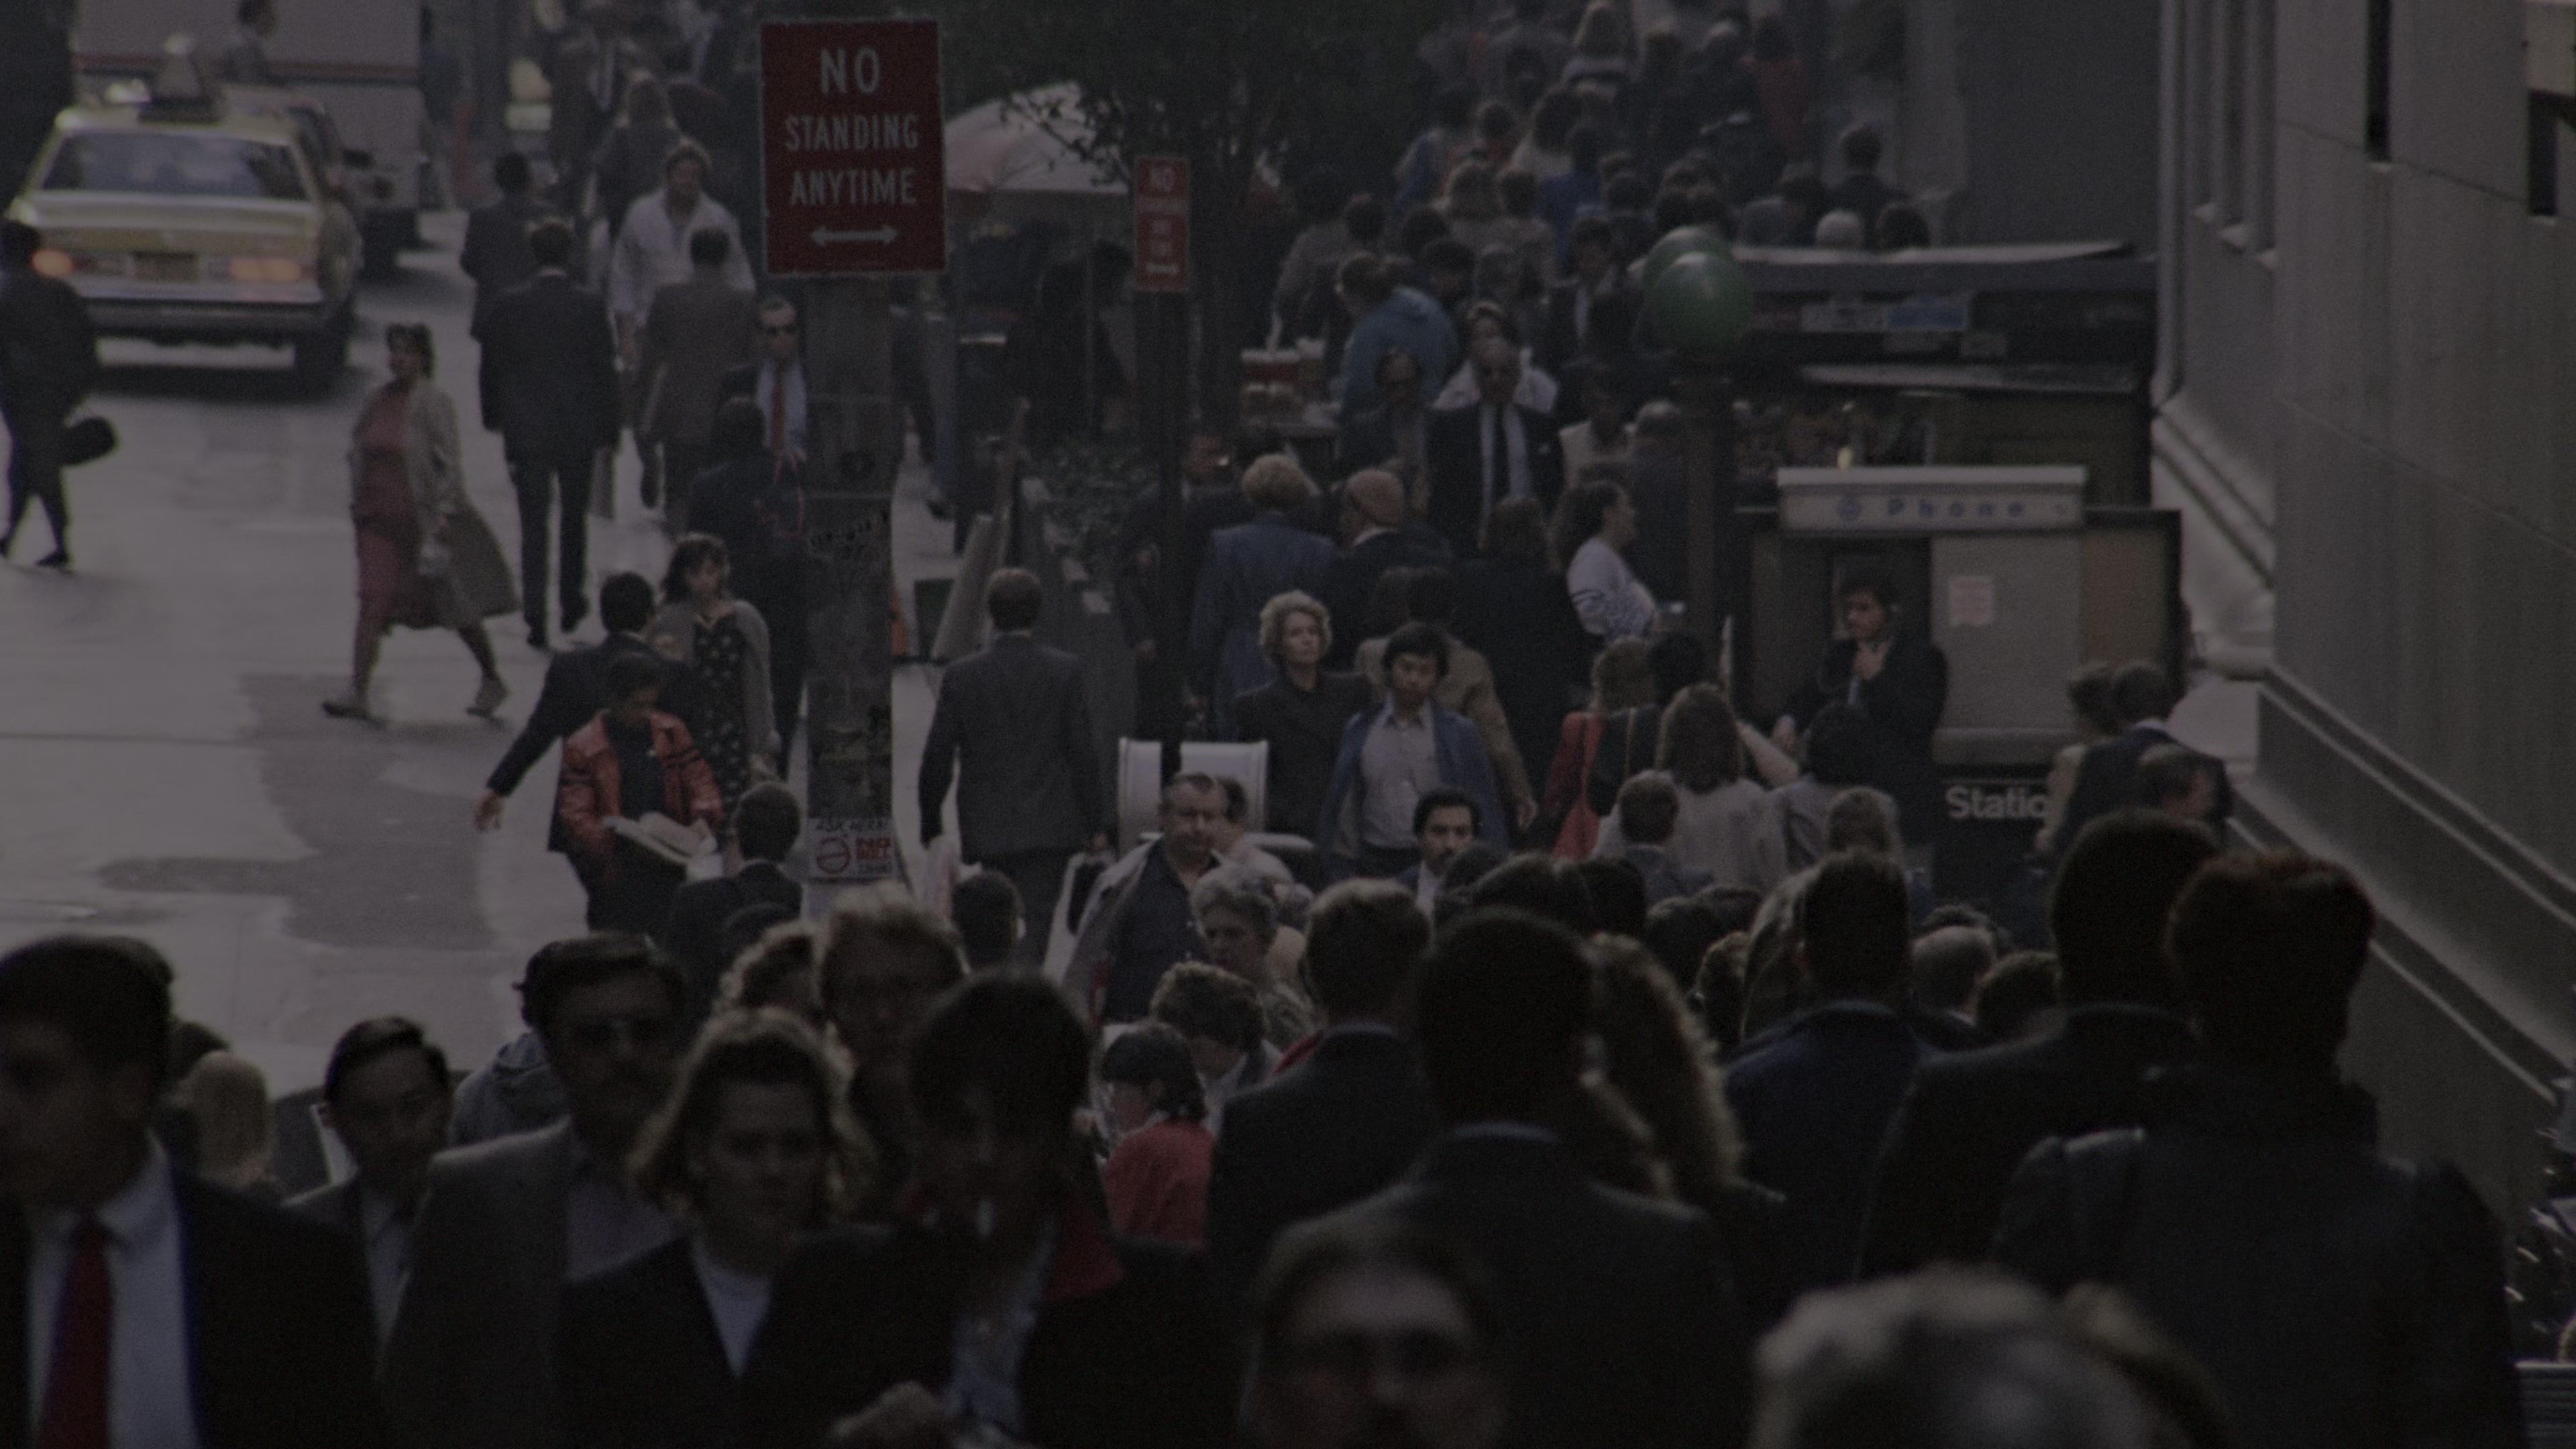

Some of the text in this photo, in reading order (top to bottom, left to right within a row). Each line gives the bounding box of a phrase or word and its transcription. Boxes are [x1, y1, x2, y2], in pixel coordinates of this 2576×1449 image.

[820, 45, 880, 95] NO
[784, 113, 920, 152] STANDING
[790, 166, 917, 206] ANYTIME
[1887, 497, 2023, 518] Phone
[1945, 784, 2051, 820] Statio
